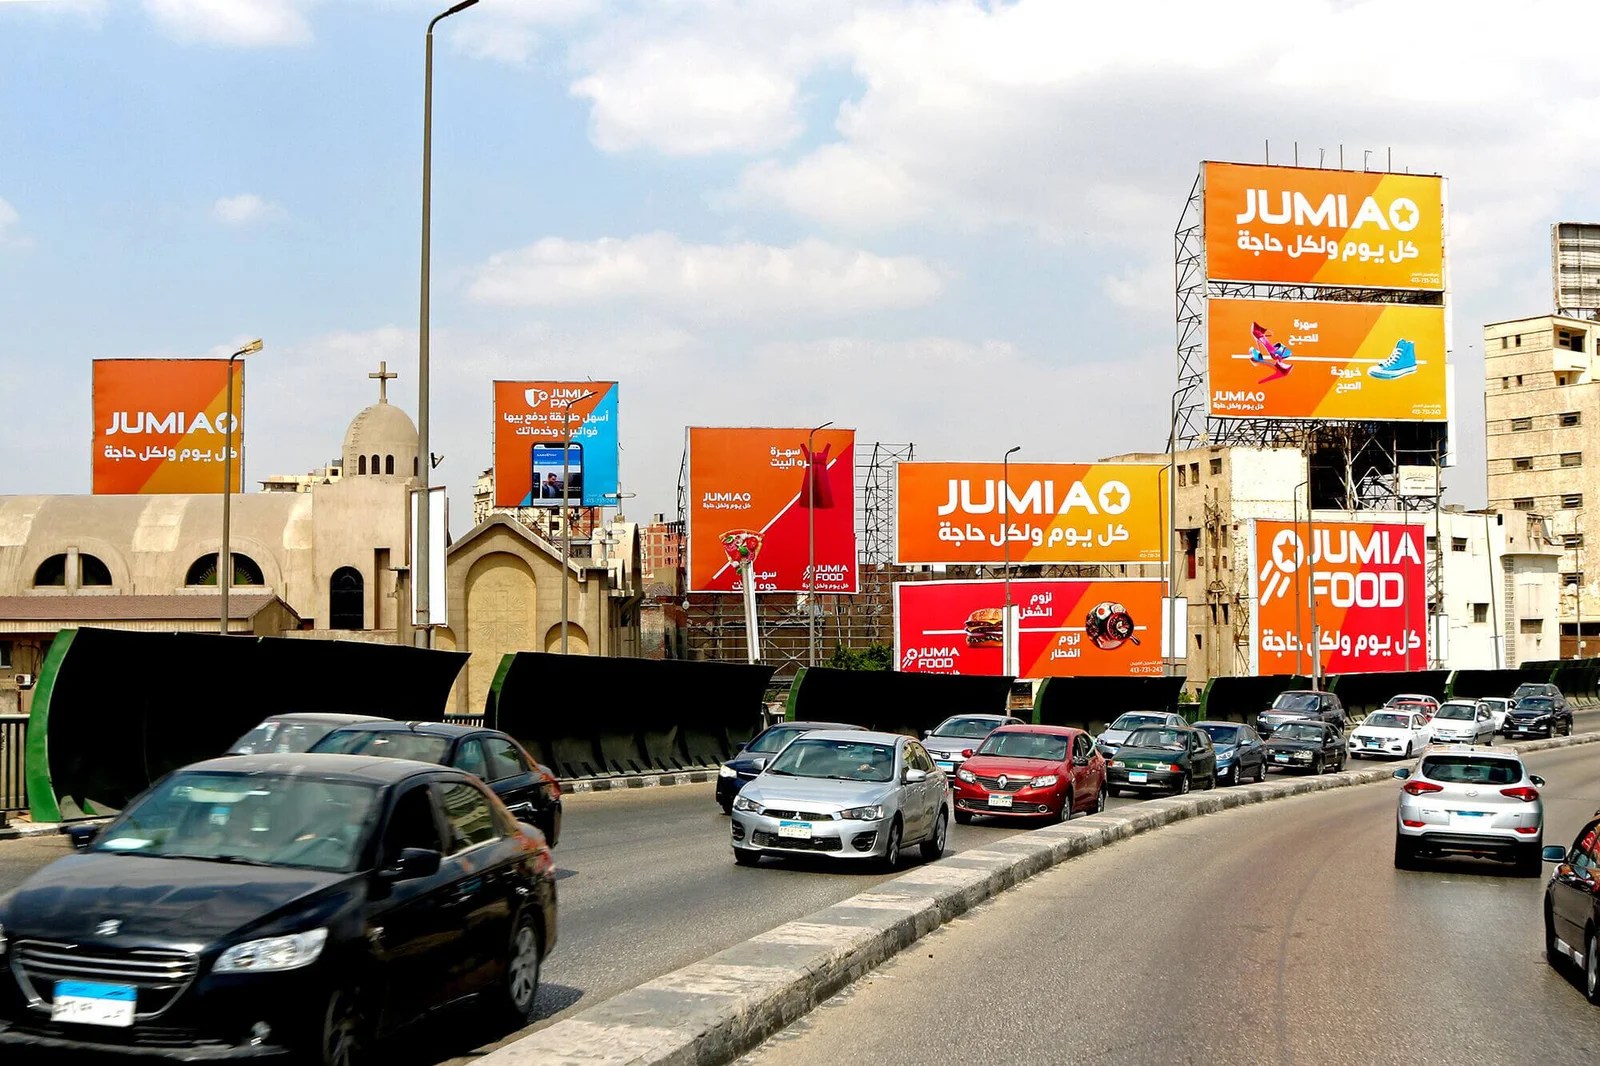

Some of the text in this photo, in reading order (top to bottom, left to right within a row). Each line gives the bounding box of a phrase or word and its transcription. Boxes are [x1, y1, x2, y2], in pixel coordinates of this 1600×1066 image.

[1237, 189, 1391, 231] JUMIA
[1238, 230, 1418, 263] كل يوم ولكل حاجة
[1294, 320, 1318, 330] سهرة
[1331, 367, 1361, 378] خروجة
[1336, 382, 1361, 393] الصبح
[550, 389, 592, 399] JUMIA
[1213, 391, 1257, 401] JUMIA
[504, 413, 523, 423] بيها
[525, 412, 547, 424] بدفع
[582, 409, 608, 424] أسهل
[106, 412, 216, 435] JUMIA
[516, 426, 558, 437] وخدماتك
[105, 446, 136, 461] حاجة
[139, 446, 176, 461] ولكل
[180, 449, 211, 461] يوم
[771, 447, 800, 457] سهرة
[771, 458, 795, 469] البيت
[703, 493, 743, 501] JUMIA
[938, 480, 1100, 515] JUMIA
[939, 522, 1129, 547] كل يوم ولكل حاجة
[1307, 530, 1421, 565] JUMIA
[816, 573, 843, 581] FOOD
[1309, 572, 1404, 607] FOOD
[1031, 592, 1052, 606] لزوم
[1019, 605, 1052, 619] الشغل
[1059, 633, 1080, 645] لزوم
[1262, 630, 1303, 657] حاجة
[1395, 630, 1420, 655] كل
[918, 647, 959, 657] JUMIA
[1355, 635, 1391, 657] يوم
[1051, 648, 1080, 660] الفطار
[919, 658, 953, 668] FOOD
